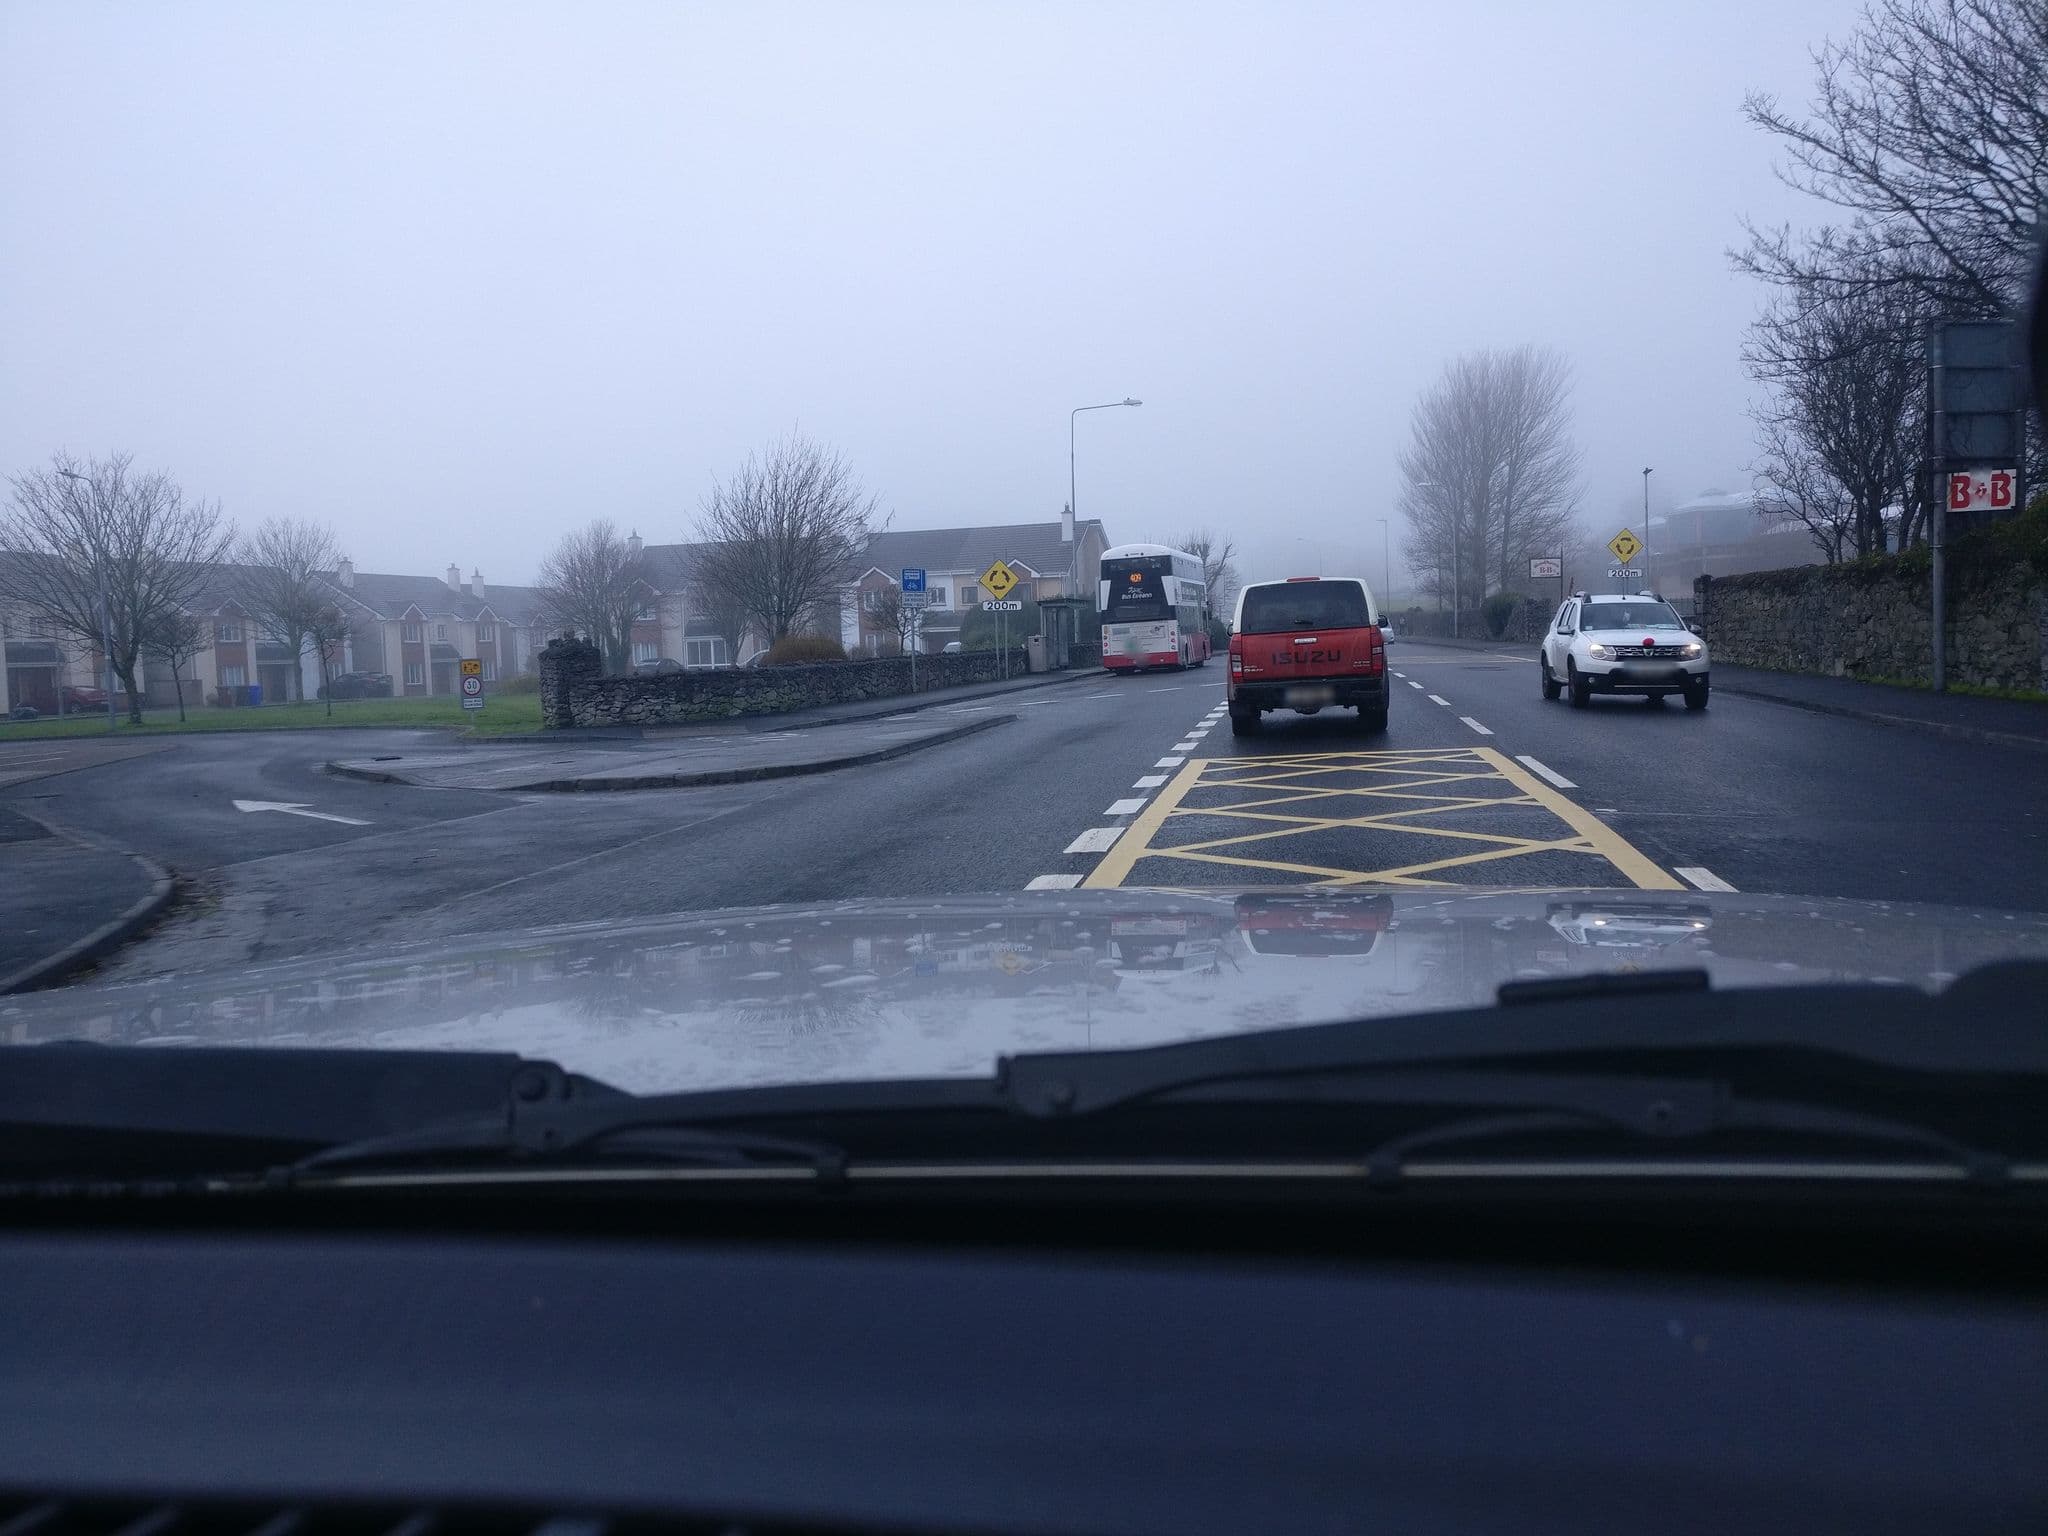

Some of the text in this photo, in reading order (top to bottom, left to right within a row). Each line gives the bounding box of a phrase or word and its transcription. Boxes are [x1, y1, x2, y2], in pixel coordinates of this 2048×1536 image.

[1612, 569, 1638, 577] 200m
[987, 601, 1018, 610] 200m
[1272, 649, 1341, 665] ISUZU
[466, 680, 477, 690] 30
